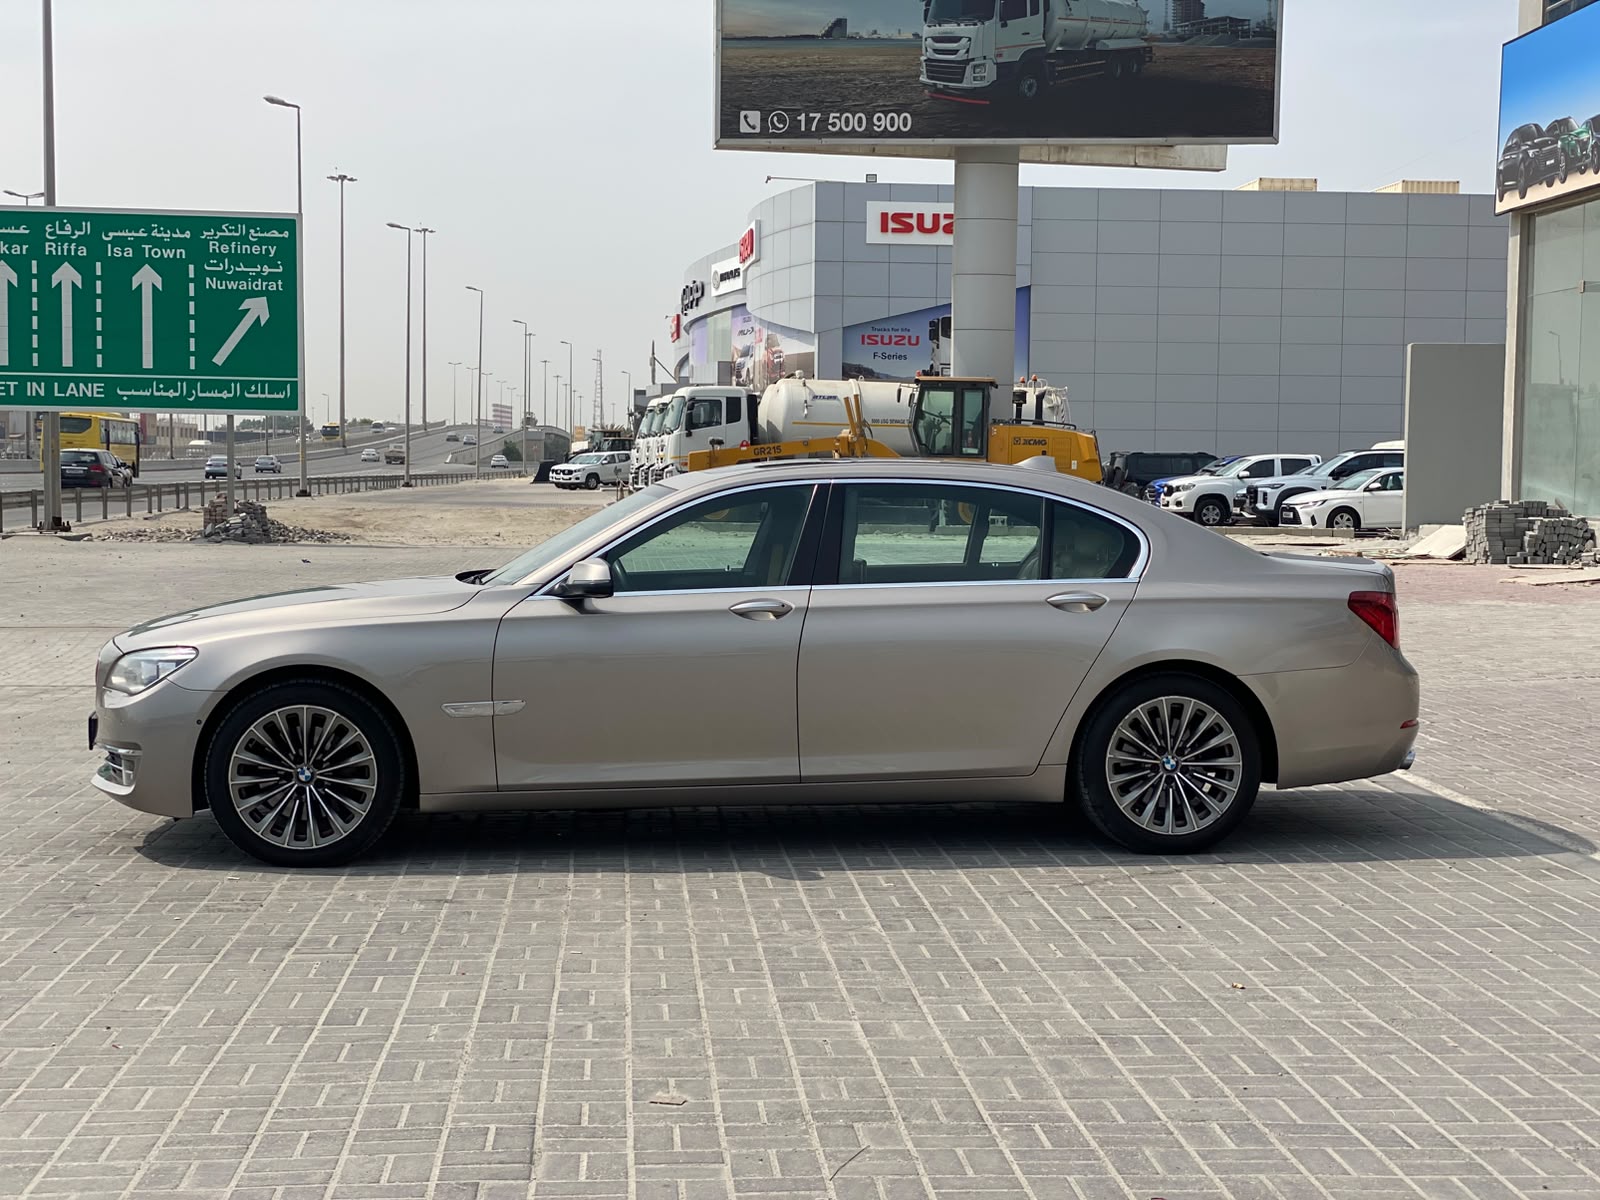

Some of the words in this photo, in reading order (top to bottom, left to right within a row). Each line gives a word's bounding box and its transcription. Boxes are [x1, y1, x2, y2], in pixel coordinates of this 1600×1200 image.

[797, 112, 821, 132] 17
[827, 112, 867, 132] 500
[873, 112, 912, 132] 900
[45, 219, 91, 240] الرفاع
[199, 223, 246, 240] التكرير
[880, 211, 954, 235] ISU
[101, 228, 148, 241] عيسى
[151, 223, 191, 242] مدينة
[248, 226, 289, 242] مصنع
[45, 241, 87, 256] Riffa
[107, 243, 133, 257] Isa
[141, 244, 186, 259] Town
[208, 240, 277, 257] Refinery
[204, 257, 283, 276] نويدرات
[205, 276, 284, 291] Nuwaidrat
[861, 334, 920, 347] ISUZU
[873, 351, 908, 361] F-Series
[26, 381, 45, 397] IN
[54, 382, 105, 398] LANE
[116, 380, 187, 401] المناسب
[187, 381, 240, 401] المسار
[244, 383, 291, 399] اسلك
[753, 445, 782, 456] GR215
